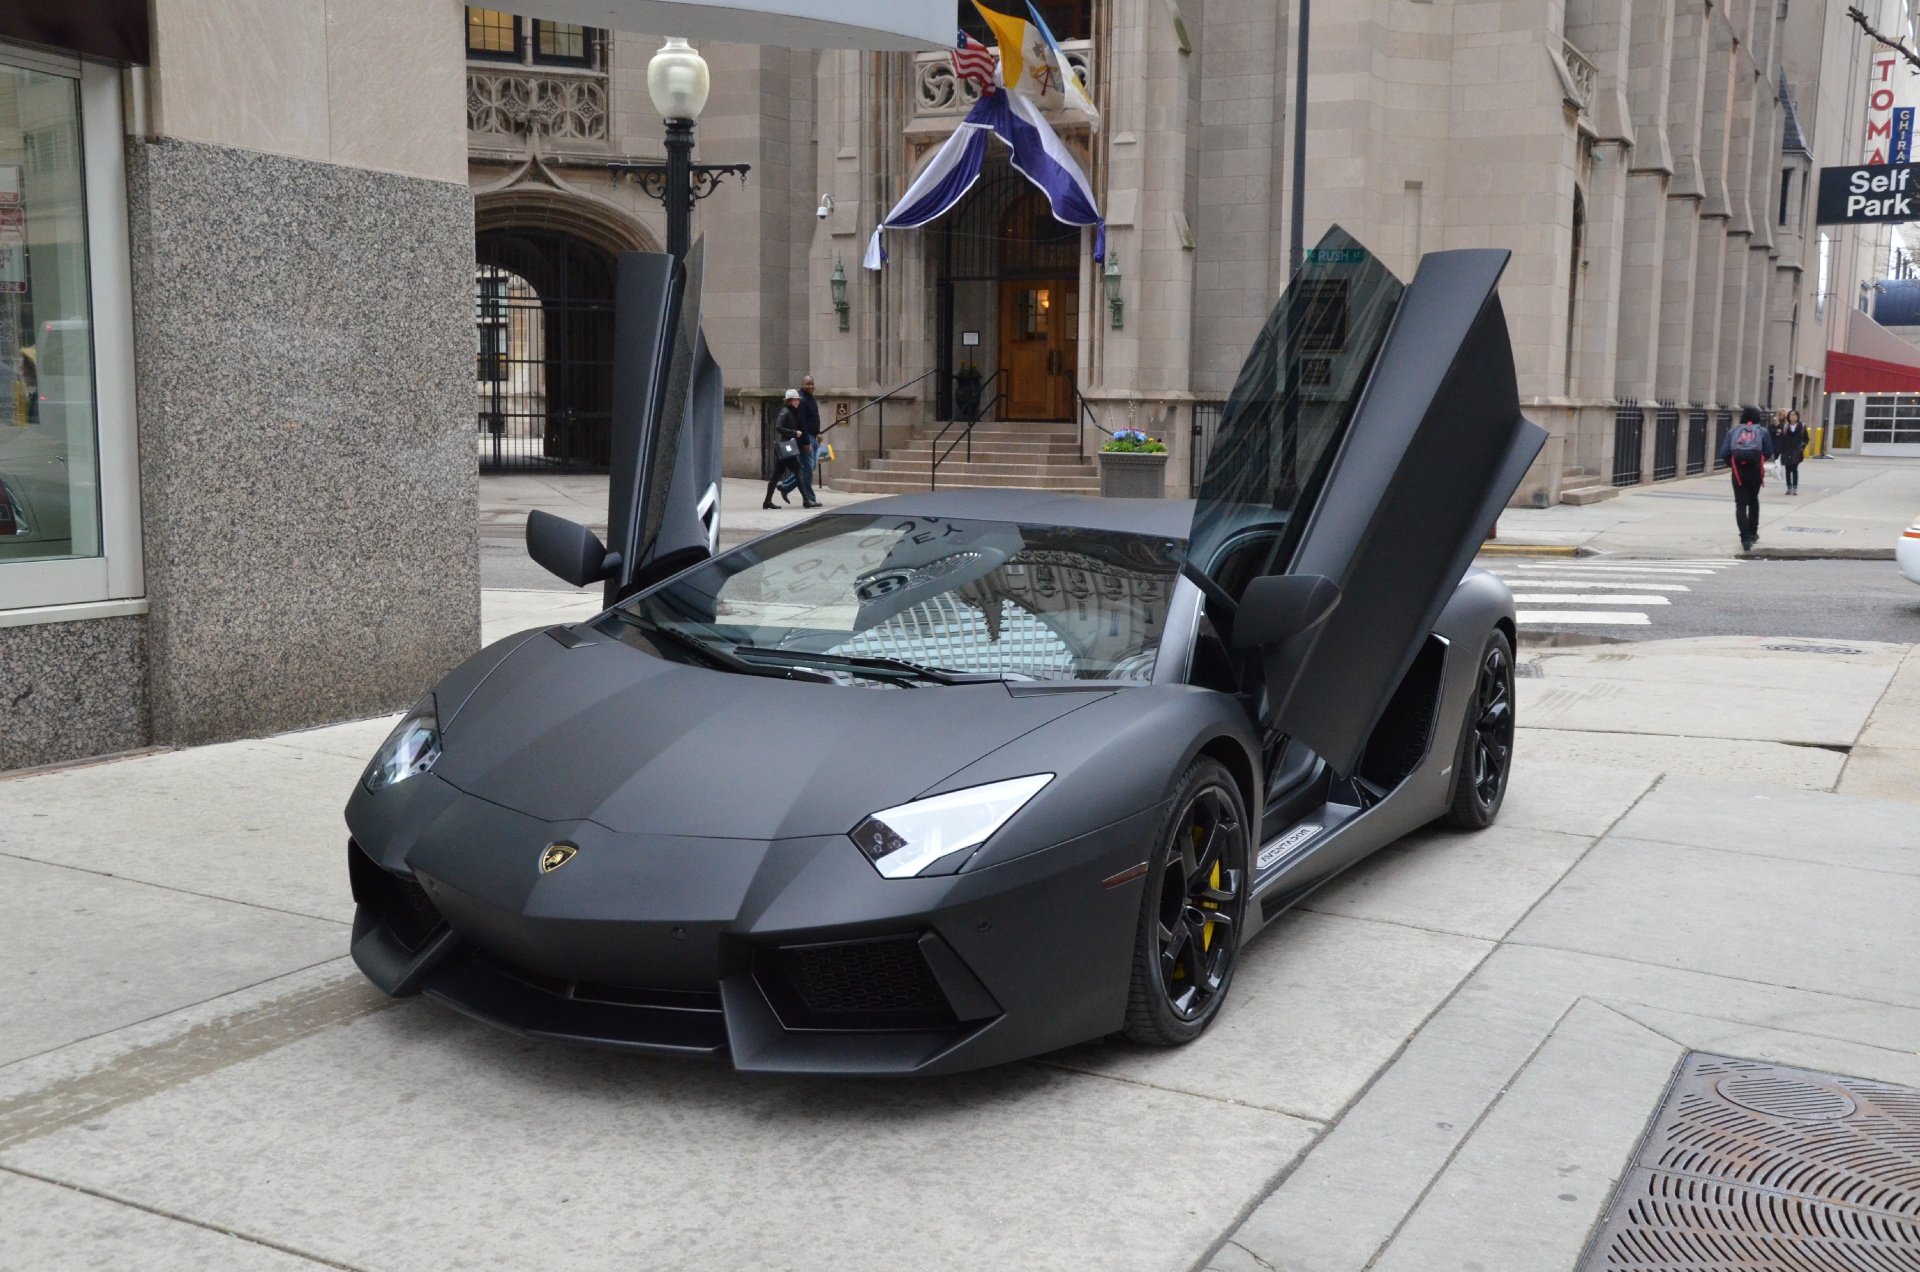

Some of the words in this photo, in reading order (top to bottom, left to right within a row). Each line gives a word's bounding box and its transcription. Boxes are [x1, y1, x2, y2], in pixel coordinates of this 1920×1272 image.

[1896, 110, 1910, 164] GHIRA
[1849, 168, 1910, 194] Self
[1847, 193, 1912, 217] Park
[1318, 250, 1349, 263] RUSH
